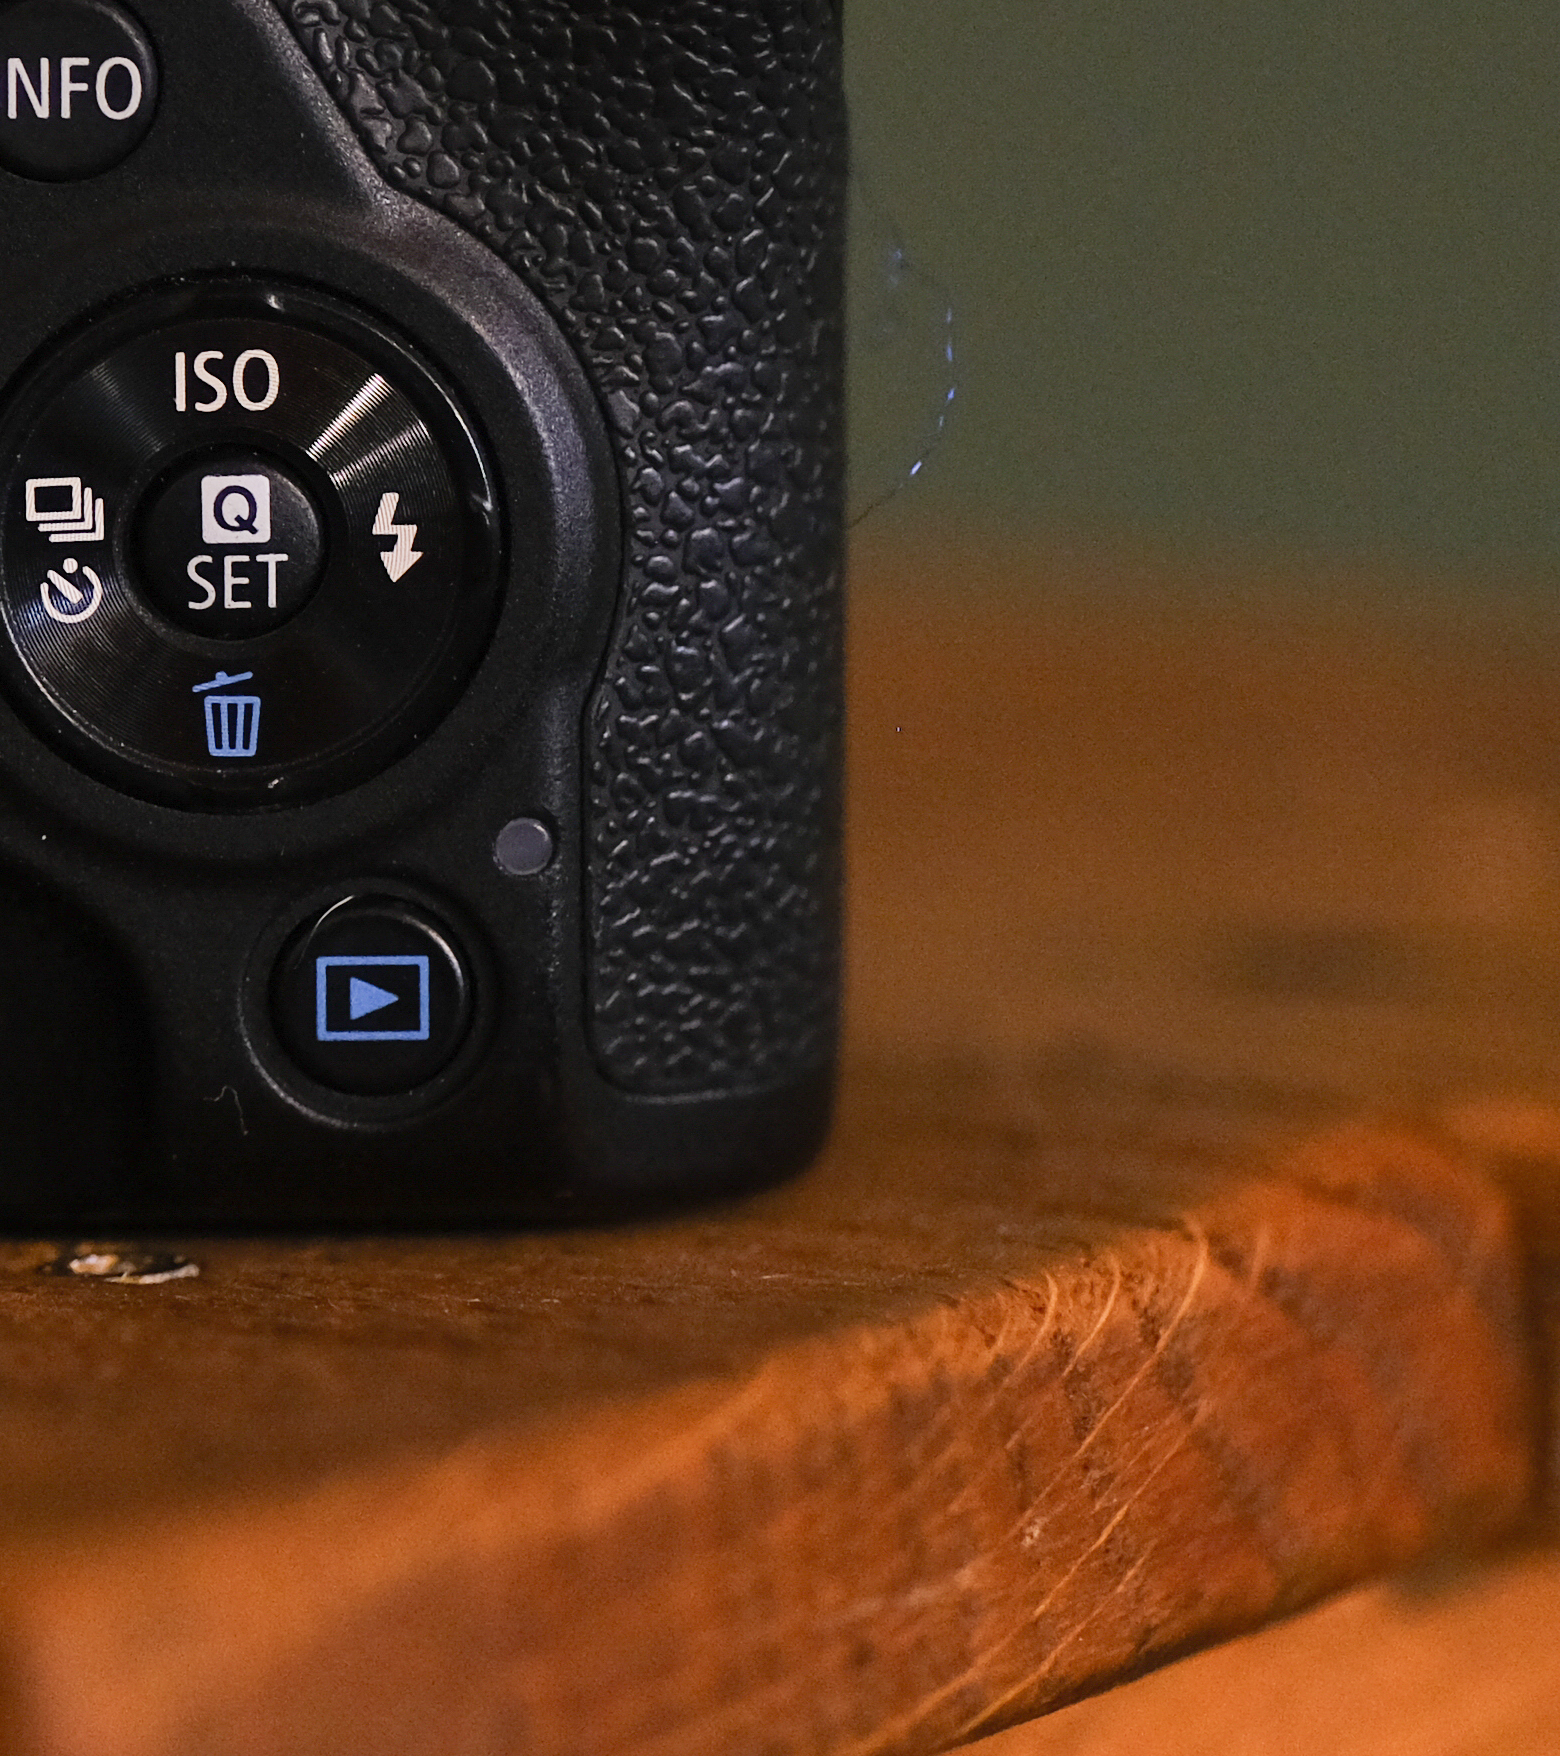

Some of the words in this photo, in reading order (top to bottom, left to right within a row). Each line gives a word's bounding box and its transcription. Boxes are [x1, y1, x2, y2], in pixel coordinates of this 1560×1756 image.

[174, 348, 280, 413] ISO
[213, 485, 259, 535] Q
[186, 553, 289, 610] SET
